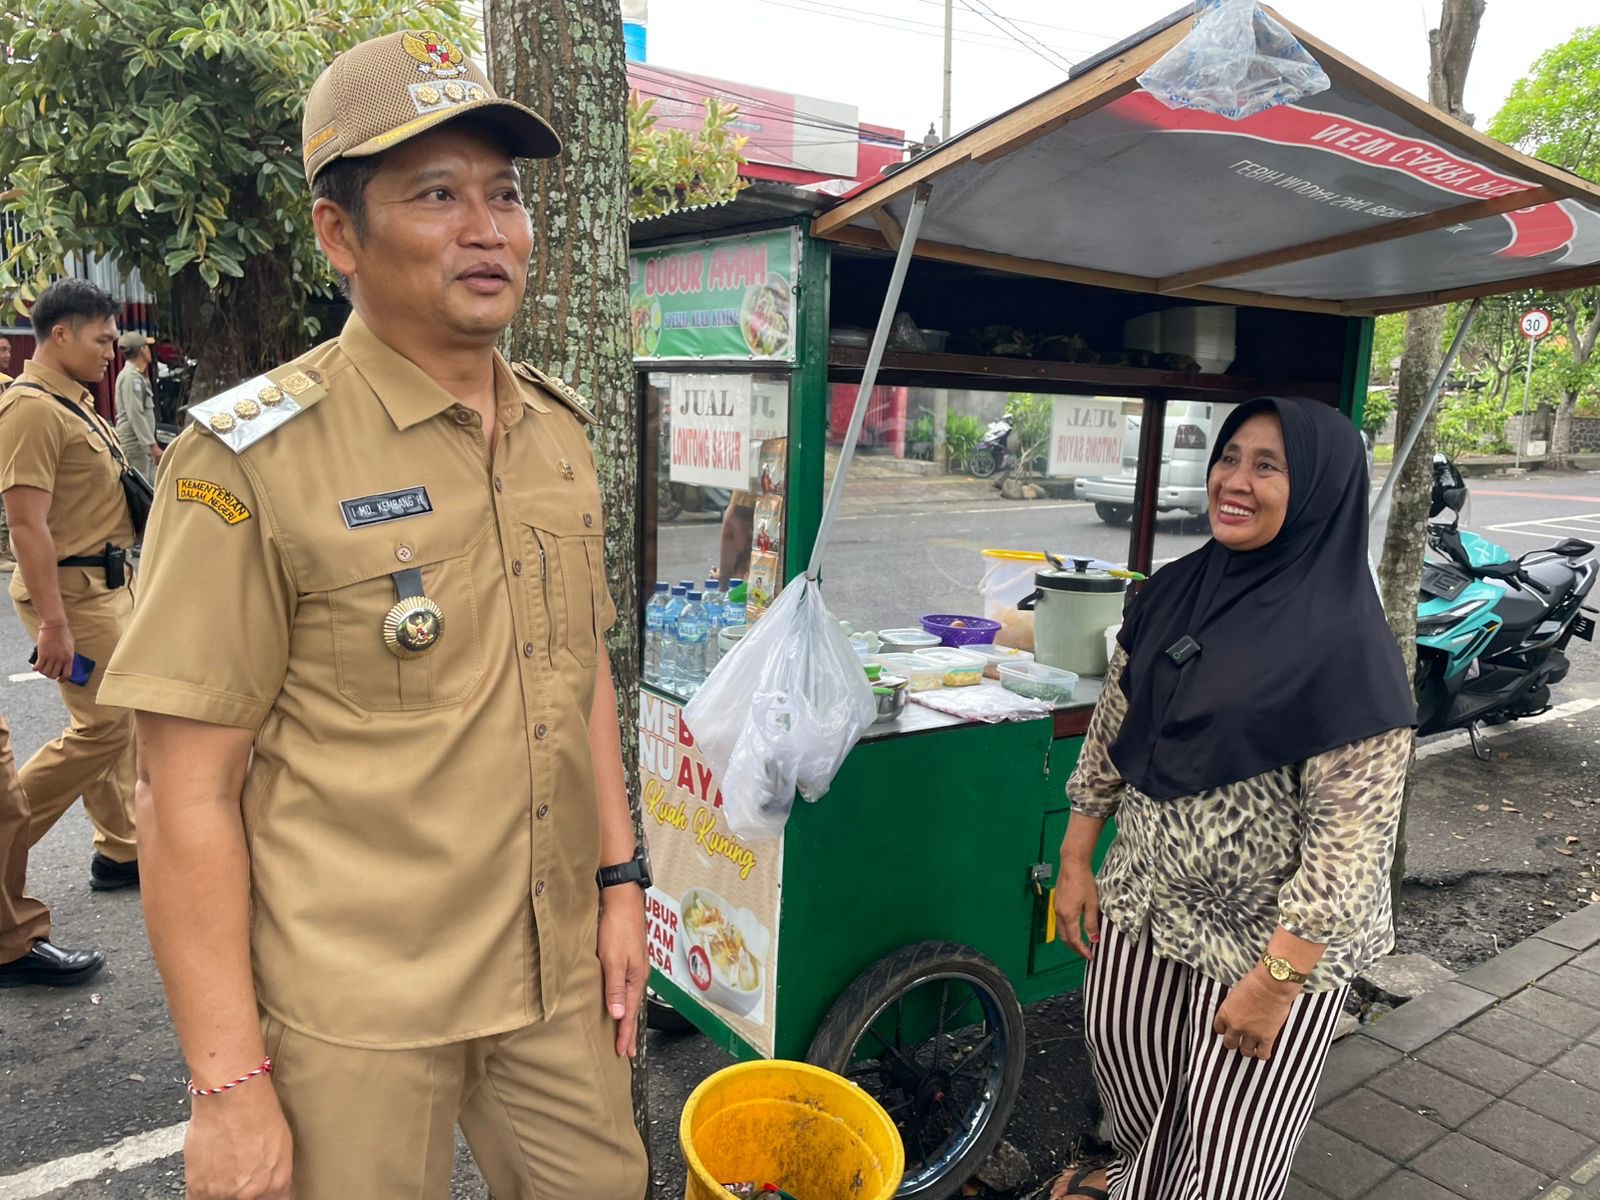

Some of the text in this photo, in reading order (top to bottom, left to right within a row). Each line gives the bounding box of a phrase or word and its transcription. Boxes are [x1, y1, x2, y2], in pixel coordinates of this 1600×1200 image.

[645, 252, 704, 297] BUBUR
[708, 244, 768, 291] AYAM
[1525, 319, 1540, 331] 30
[680, 389, 735, 417] JUAL
[673, 427, 742, 472] LONTONG SAYUR
[180, 489, 237, 521] DALAM NEGERI
[181, 480, 247, 517] KEMENTERIAN
[350, 507, 357, 518] I
[376, 495, 414, 513] KEMBANG
[638, 691, 677, 746] ME
[638, 731, 676, 782] NU
[644, 779, 757, 880] Kuah Kuning
[646, 896, 678, 933] UBUR
[646, 919, 675, 954] YAM
[648, 942, 673, 976] ASA
